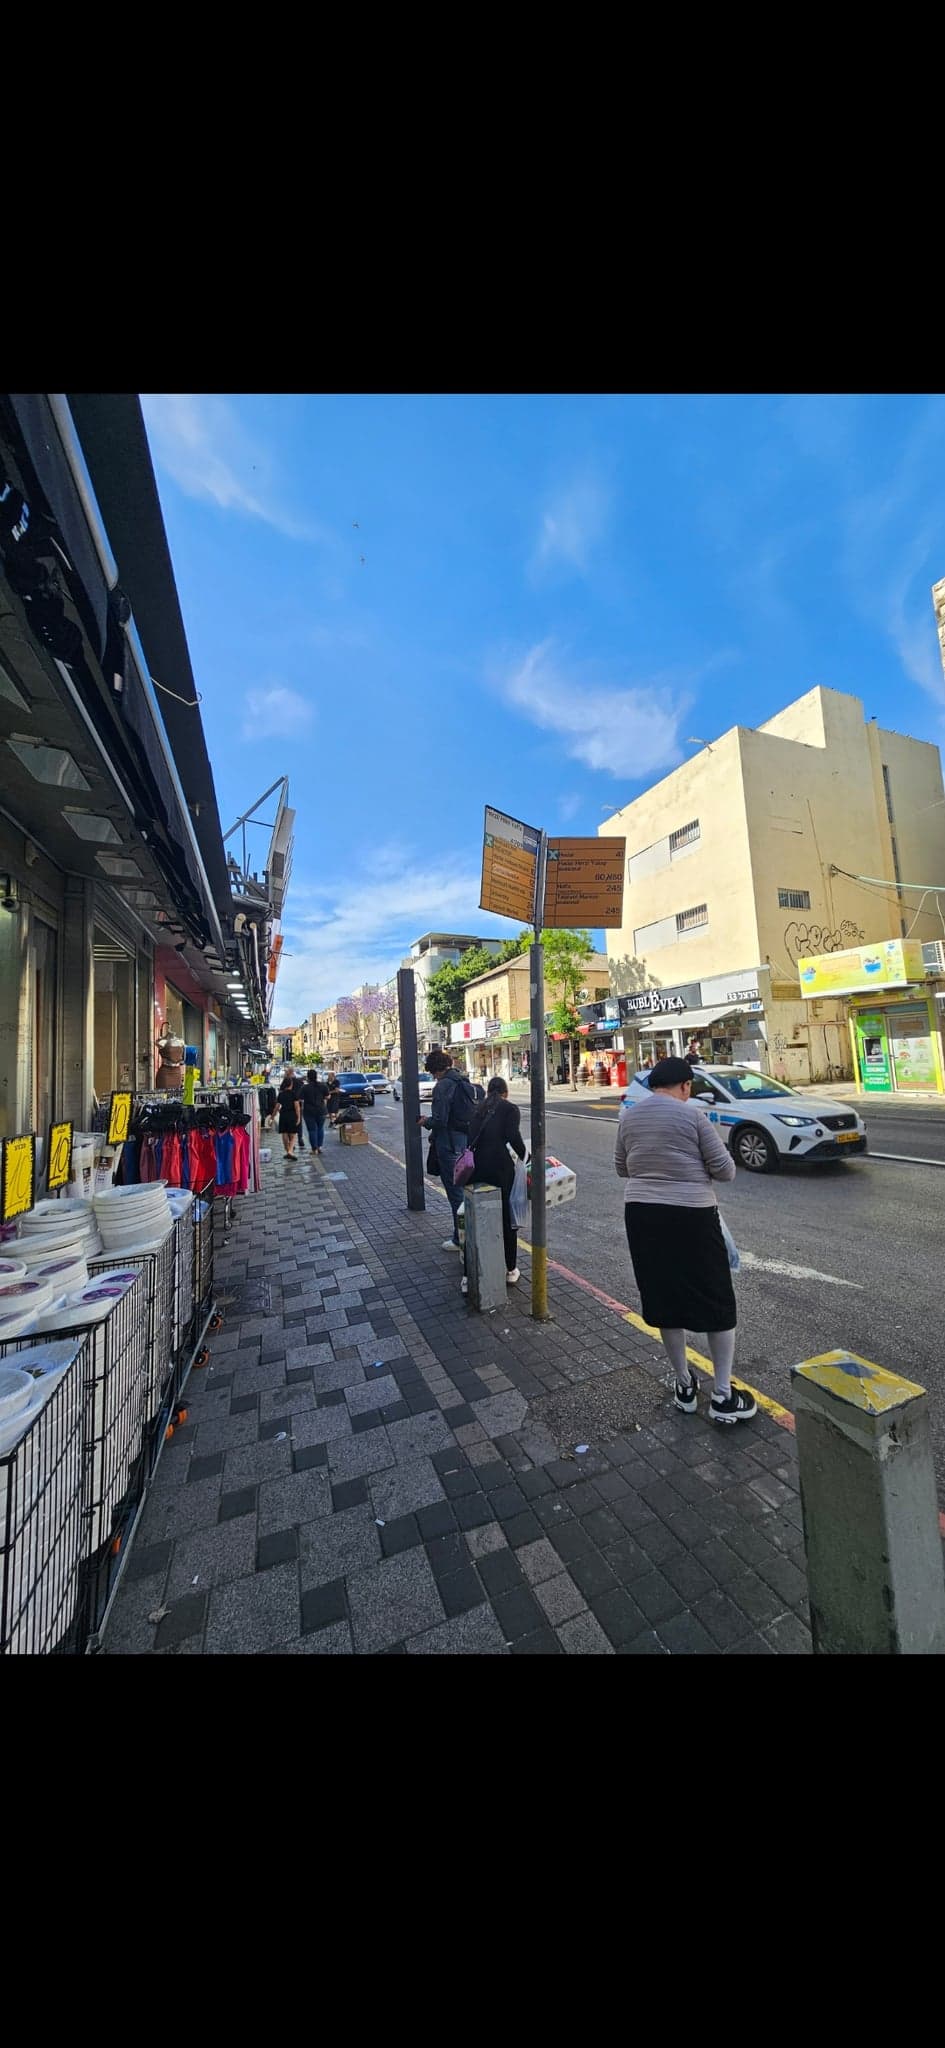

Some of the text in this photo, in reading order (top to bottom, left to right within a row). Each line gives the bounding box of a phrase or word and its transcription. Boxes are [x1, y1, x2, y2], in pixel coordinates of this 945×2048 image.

[727, 992, 737, 1002] 33
[112, 1104, 128, 1136] 10
[50, 1135, 70, 1180] 10
[7, 1151, 30, 1204] 10
